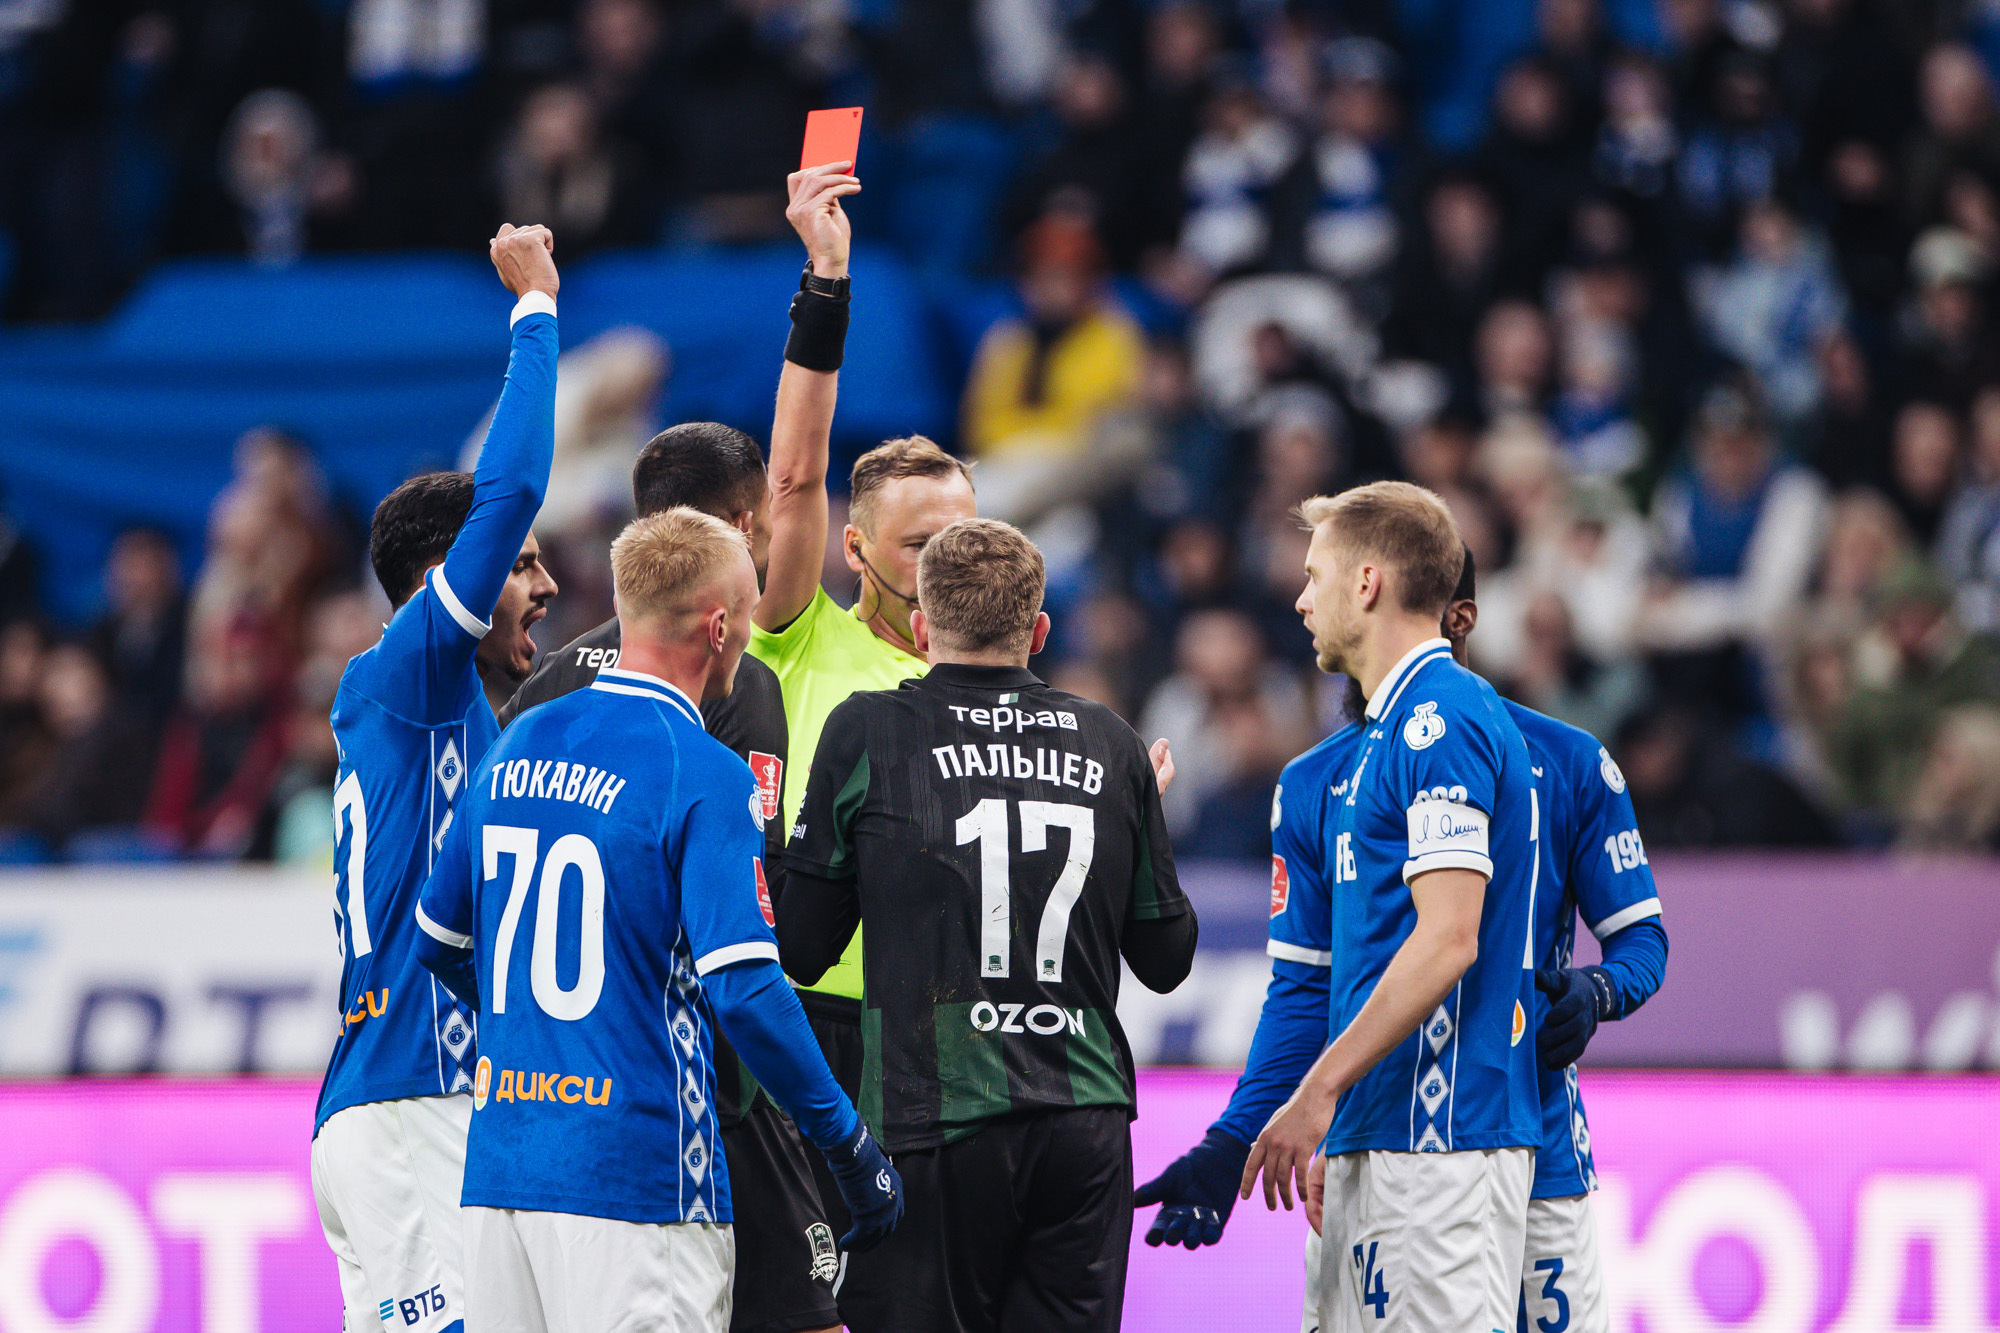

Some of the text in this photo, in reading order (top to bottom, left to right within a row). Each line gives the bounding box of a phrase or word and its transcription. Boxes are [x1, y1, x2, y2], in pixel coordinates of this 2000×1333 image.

[948, 704, 1058, 733] терра
[491, 758, 627, 815] ТЮКАВИН
[932, 743, 1104, 796] ПАЛЬЦЕВ
[955, 798, 1094, 983] 17
[482, 825, 606, 1021] 70
[970, 1000, 1087, 1038] OZON
[398, 1283, 446, 1327] ВТБ
